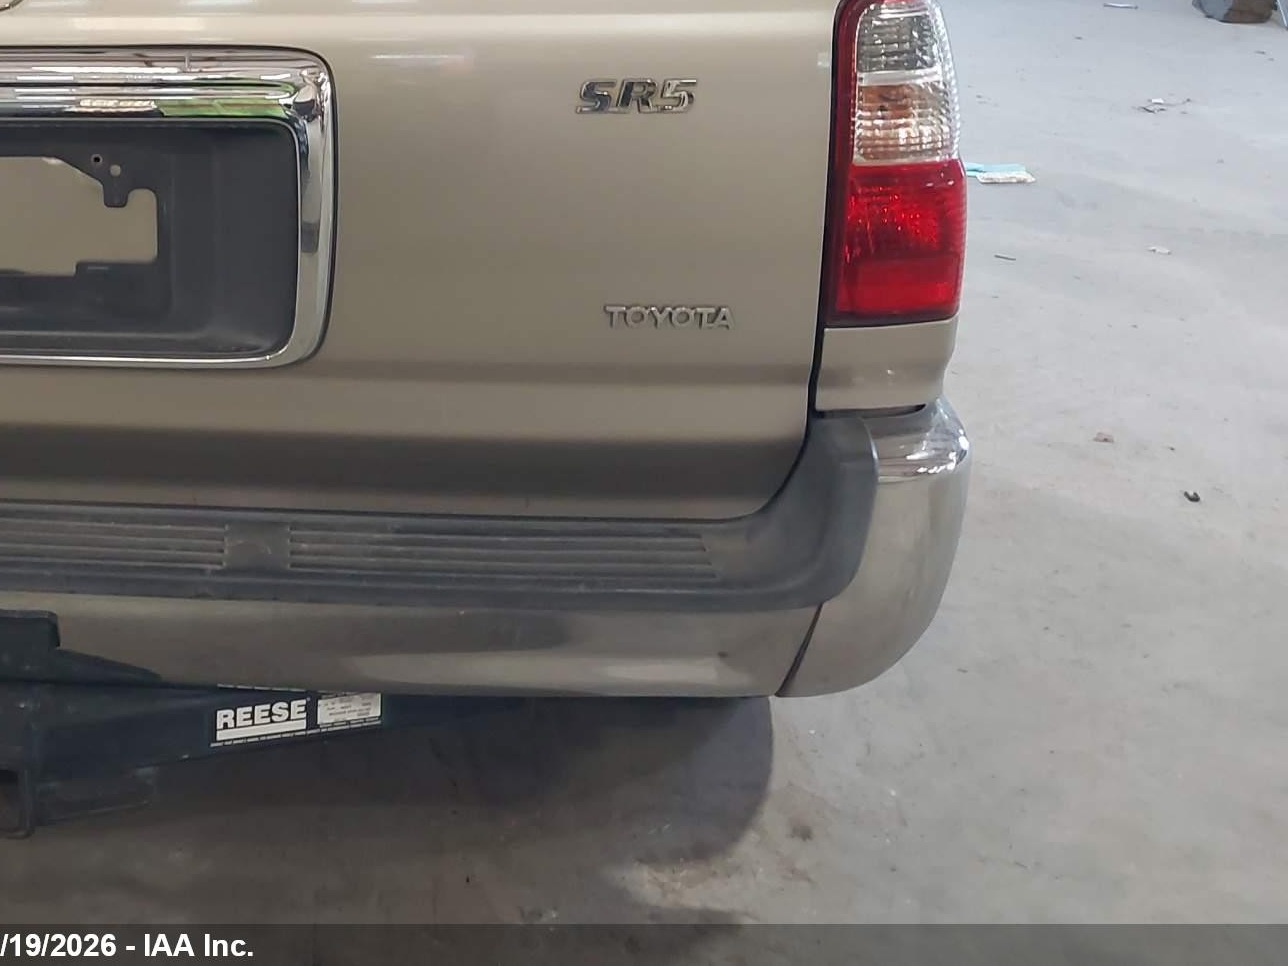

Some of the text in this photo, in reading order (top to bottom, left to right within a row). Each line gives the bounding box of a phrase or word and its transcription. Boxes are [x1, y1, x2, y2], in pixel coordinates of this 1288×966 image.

[575, 78, 698, 115] SR5
[603, 303, 735, 331] TOYOTA
[216, 698, 307, 730] REESE
